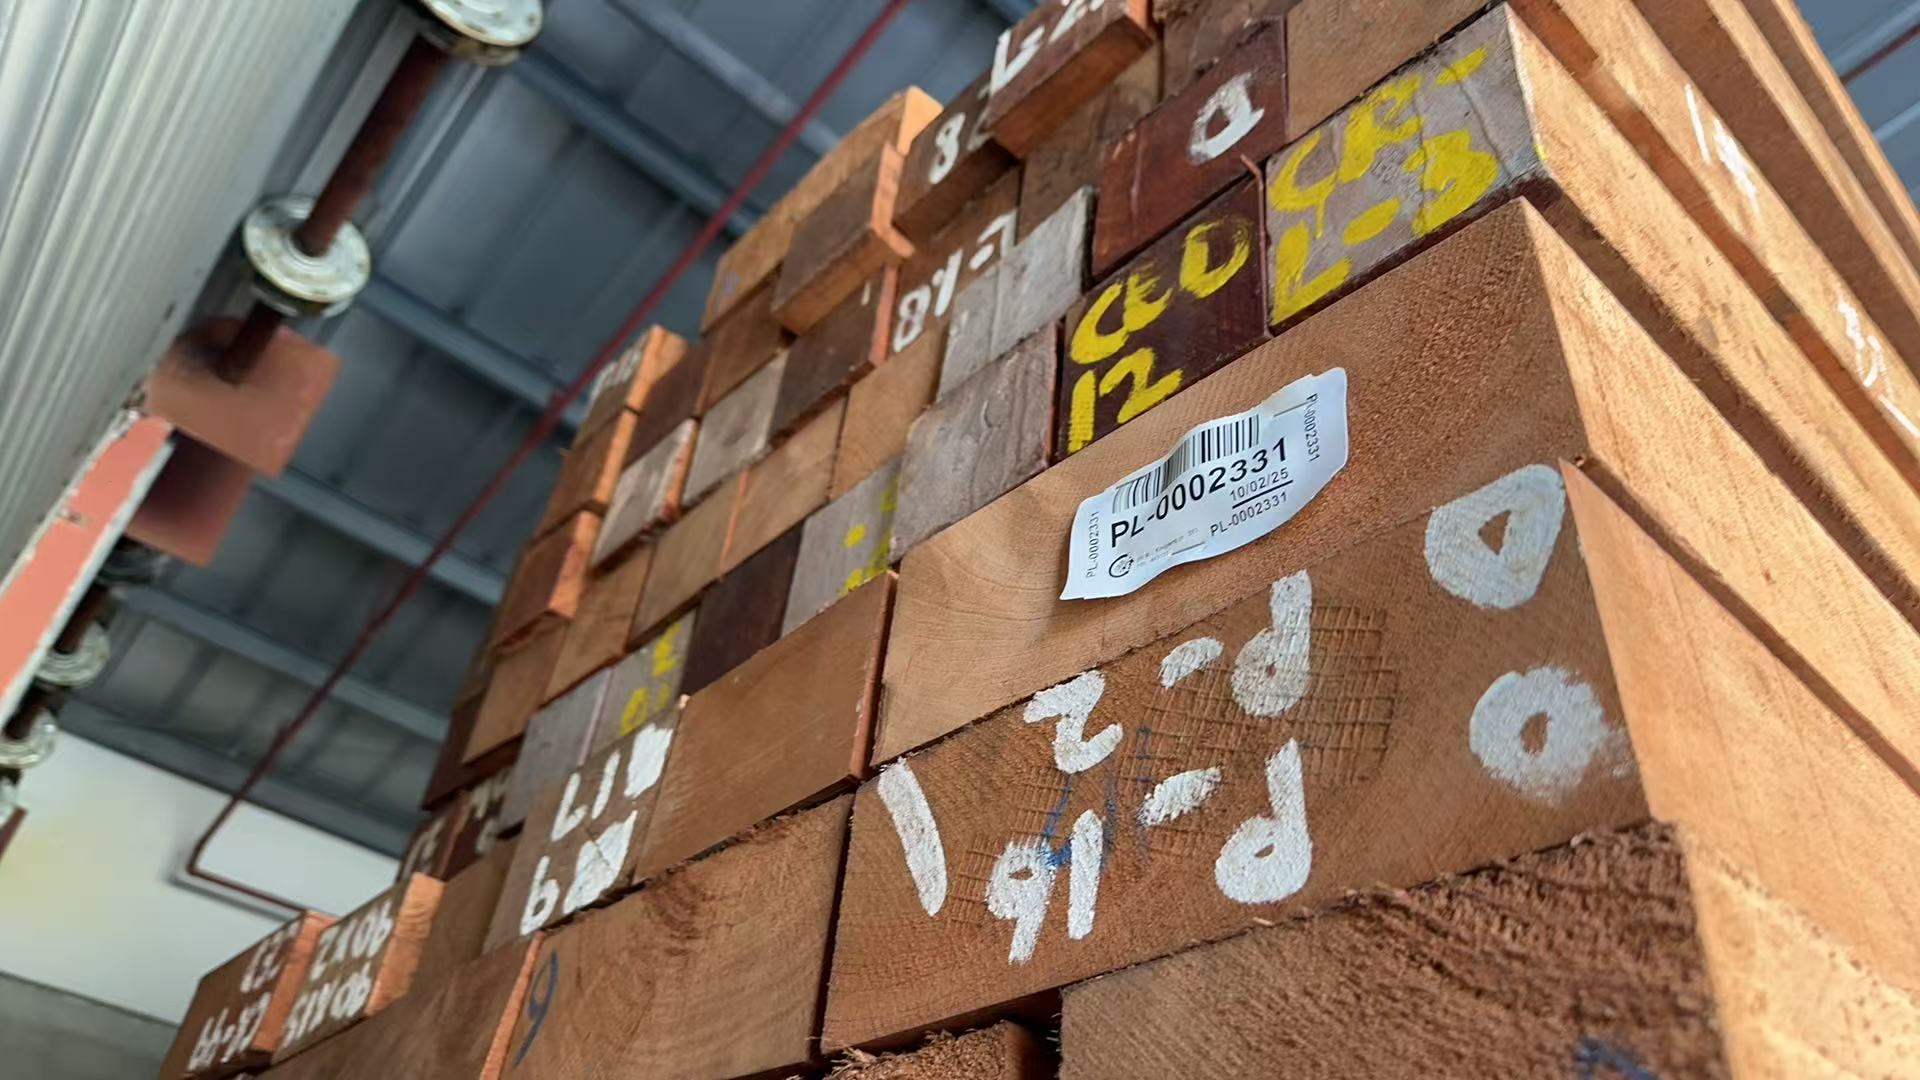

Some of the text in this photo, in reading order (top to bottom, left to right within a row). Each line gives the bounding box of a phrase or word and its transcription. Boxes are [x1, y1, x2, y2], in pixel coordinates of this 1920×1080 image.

[1067, 346, 1183, 454] 12
[1304, 393, 1320, 462] PL-0002331
[1110, 436, 1287, 548] PL-0002331
[1210, 492, 1287, 537] PL-0002331
[1229, 467, 1289, 501] 10/02/25
[1086, 510, 1099, 578] PL-0002331
